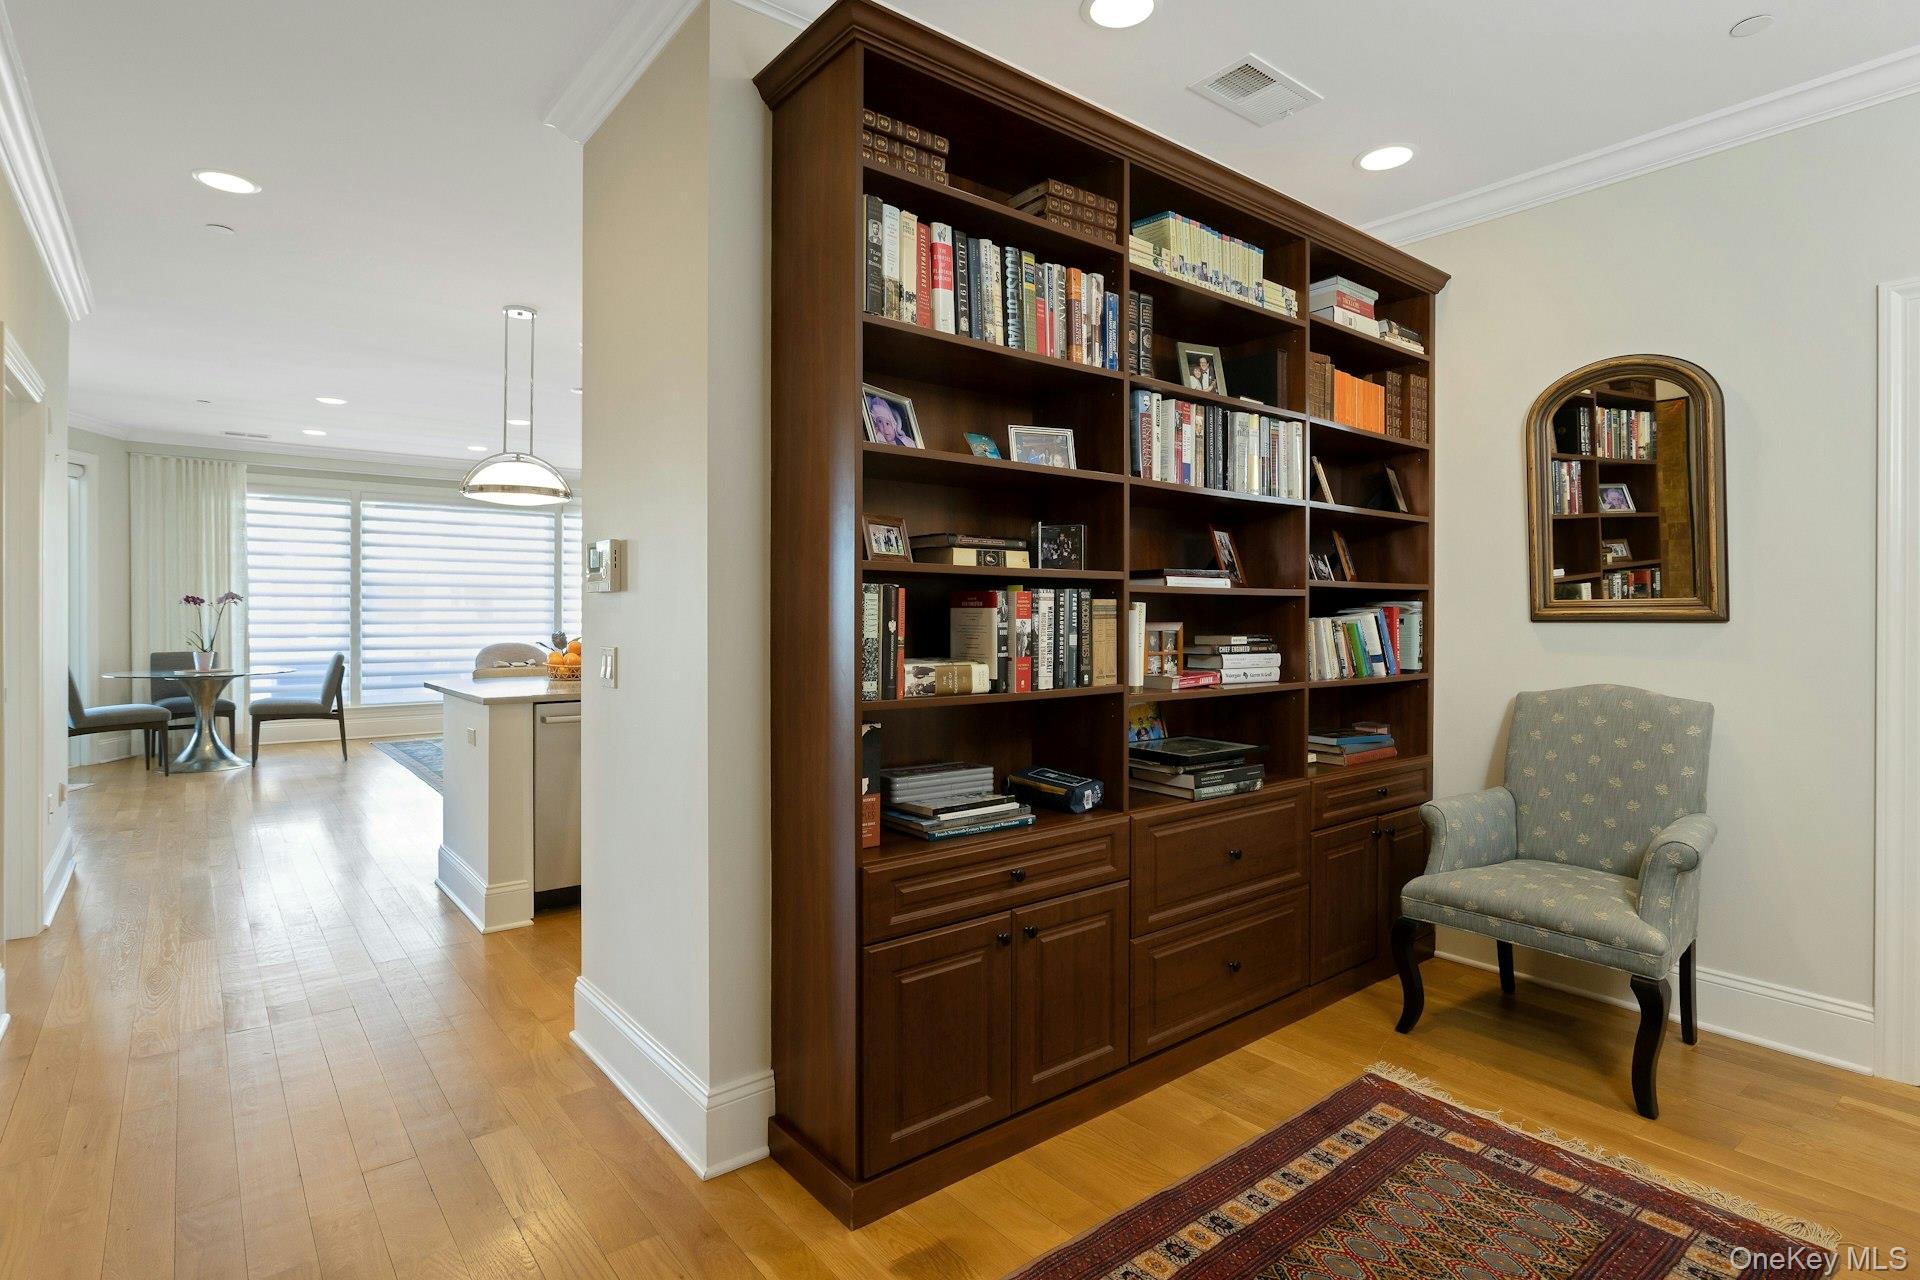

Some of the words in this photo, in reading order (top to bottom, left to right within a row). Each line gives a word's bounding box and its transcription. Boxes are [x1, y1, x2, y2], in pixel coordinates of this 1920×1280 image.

[958, 242, 967, 275] JULY
[1058, 279, 1066, 321] TITAN
[1081, 600, 1089, 634] MODERN
[1081, 635, 1089, 658] TIMES
